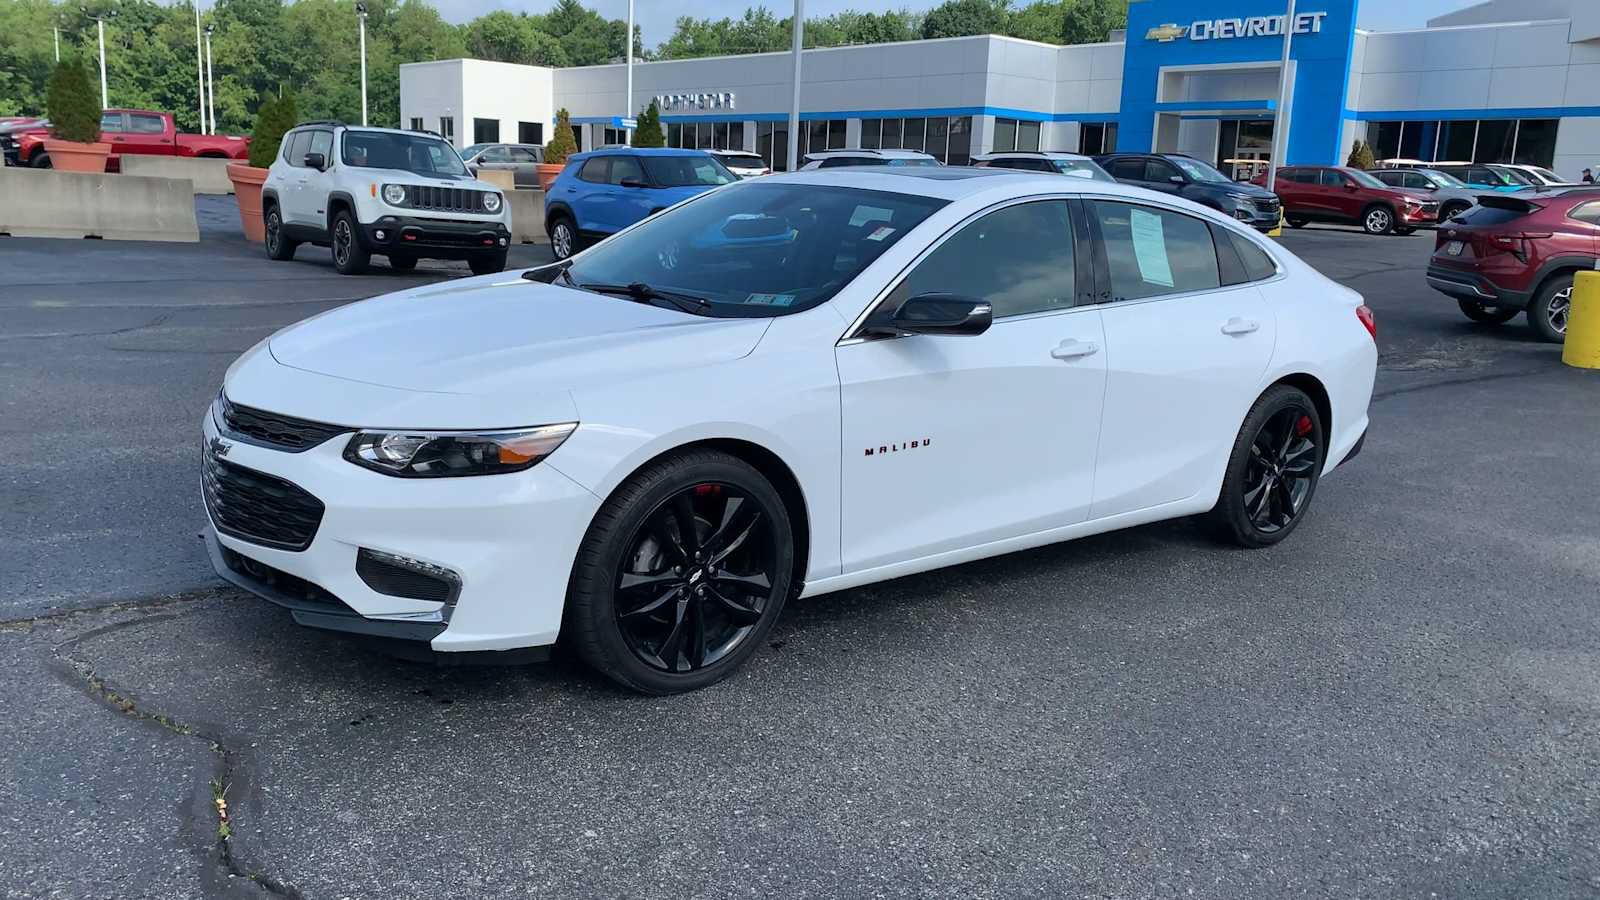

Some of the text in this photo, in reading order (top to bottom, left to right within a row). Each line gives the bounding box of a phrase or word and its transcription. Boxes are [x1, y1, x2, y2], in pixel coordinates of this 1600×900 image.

[1190, 11, 1327, 41] CHEVROLET
[652, 92, 736, 111] NORTHSTAR
[864, 438, 931, 456] MALIBU
